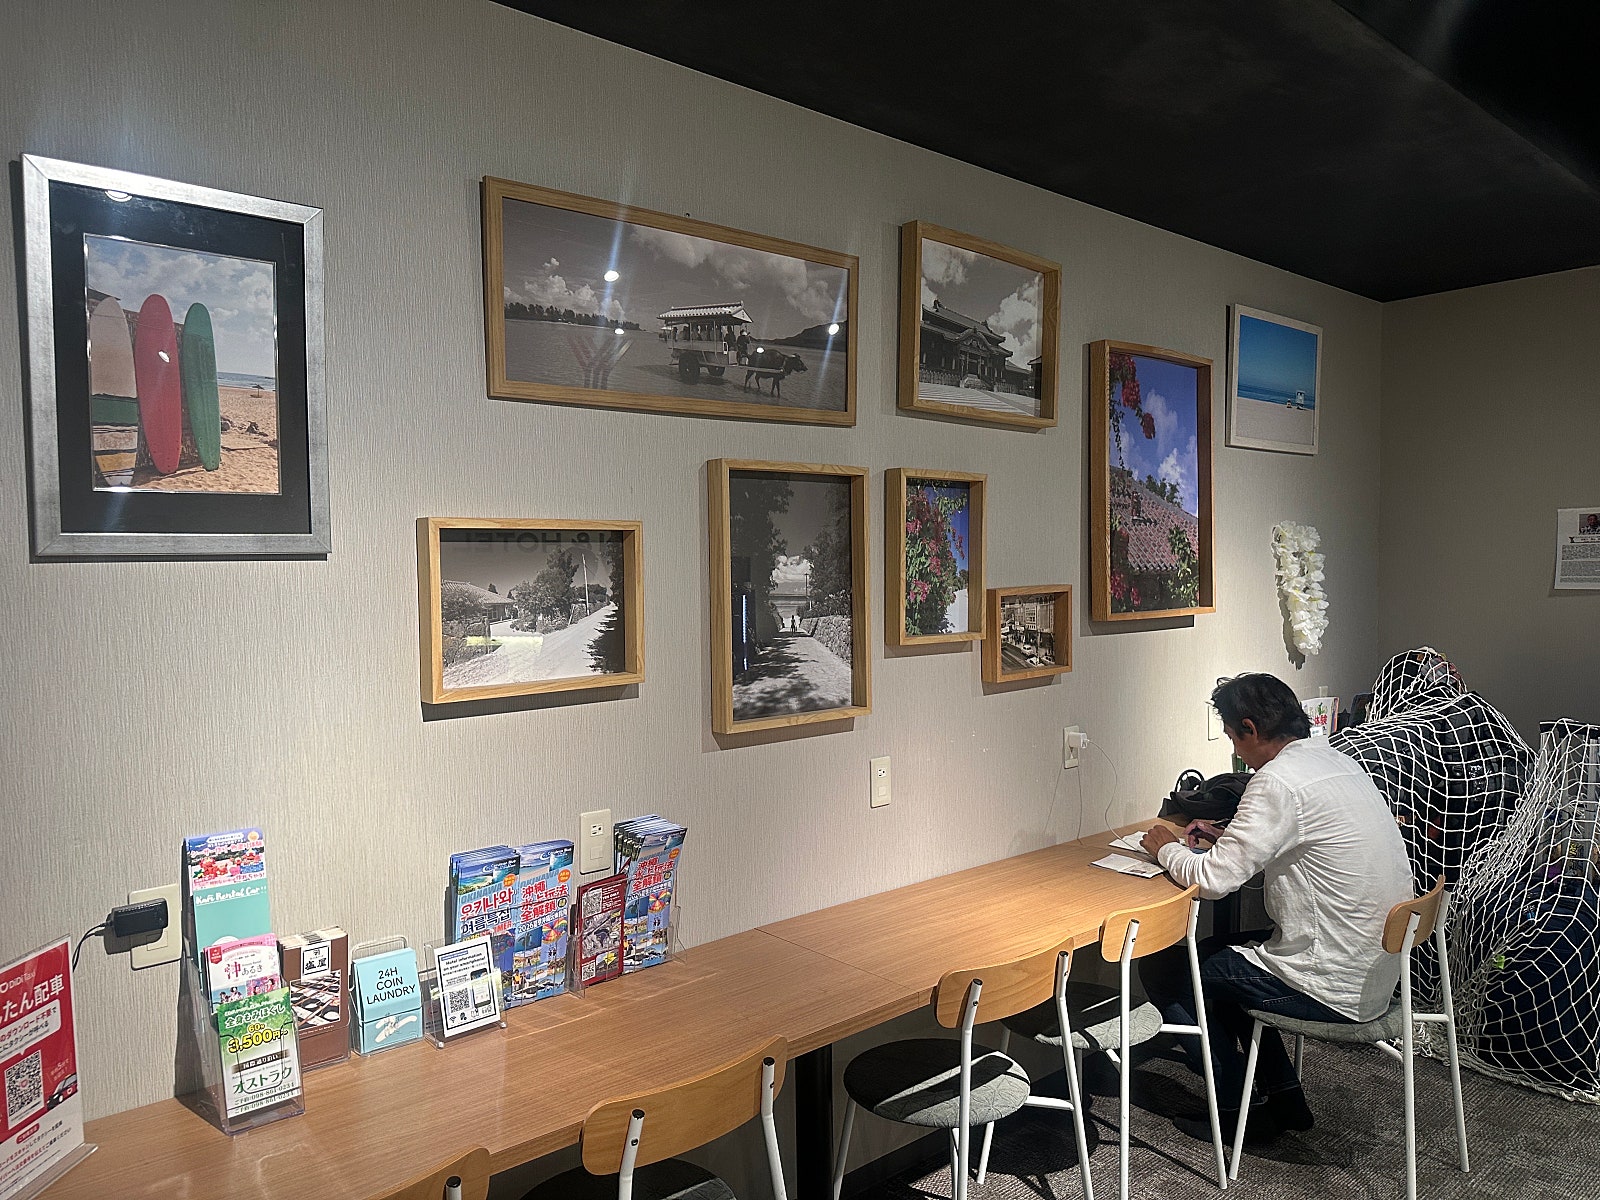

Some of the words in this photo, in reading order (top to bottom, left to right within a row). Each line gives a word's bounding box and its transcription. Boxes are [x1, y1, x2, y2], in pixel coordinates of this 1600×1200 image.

[216, 887, 245, 900] Rental
[246, 887, 260, 895] Car
[461, 884, 502, 904] OKINAWA
[461, 907, 510, 934] 여름특집
[378, 966, 398, 979] 24H
[376, 976, 404, 991] COIN
[366, 984, 416, 1005] LAUNDRY
[226, 1004, 286, 1028] 全身もみほぐし
[233, 1066, 292, 1094] オストラク
